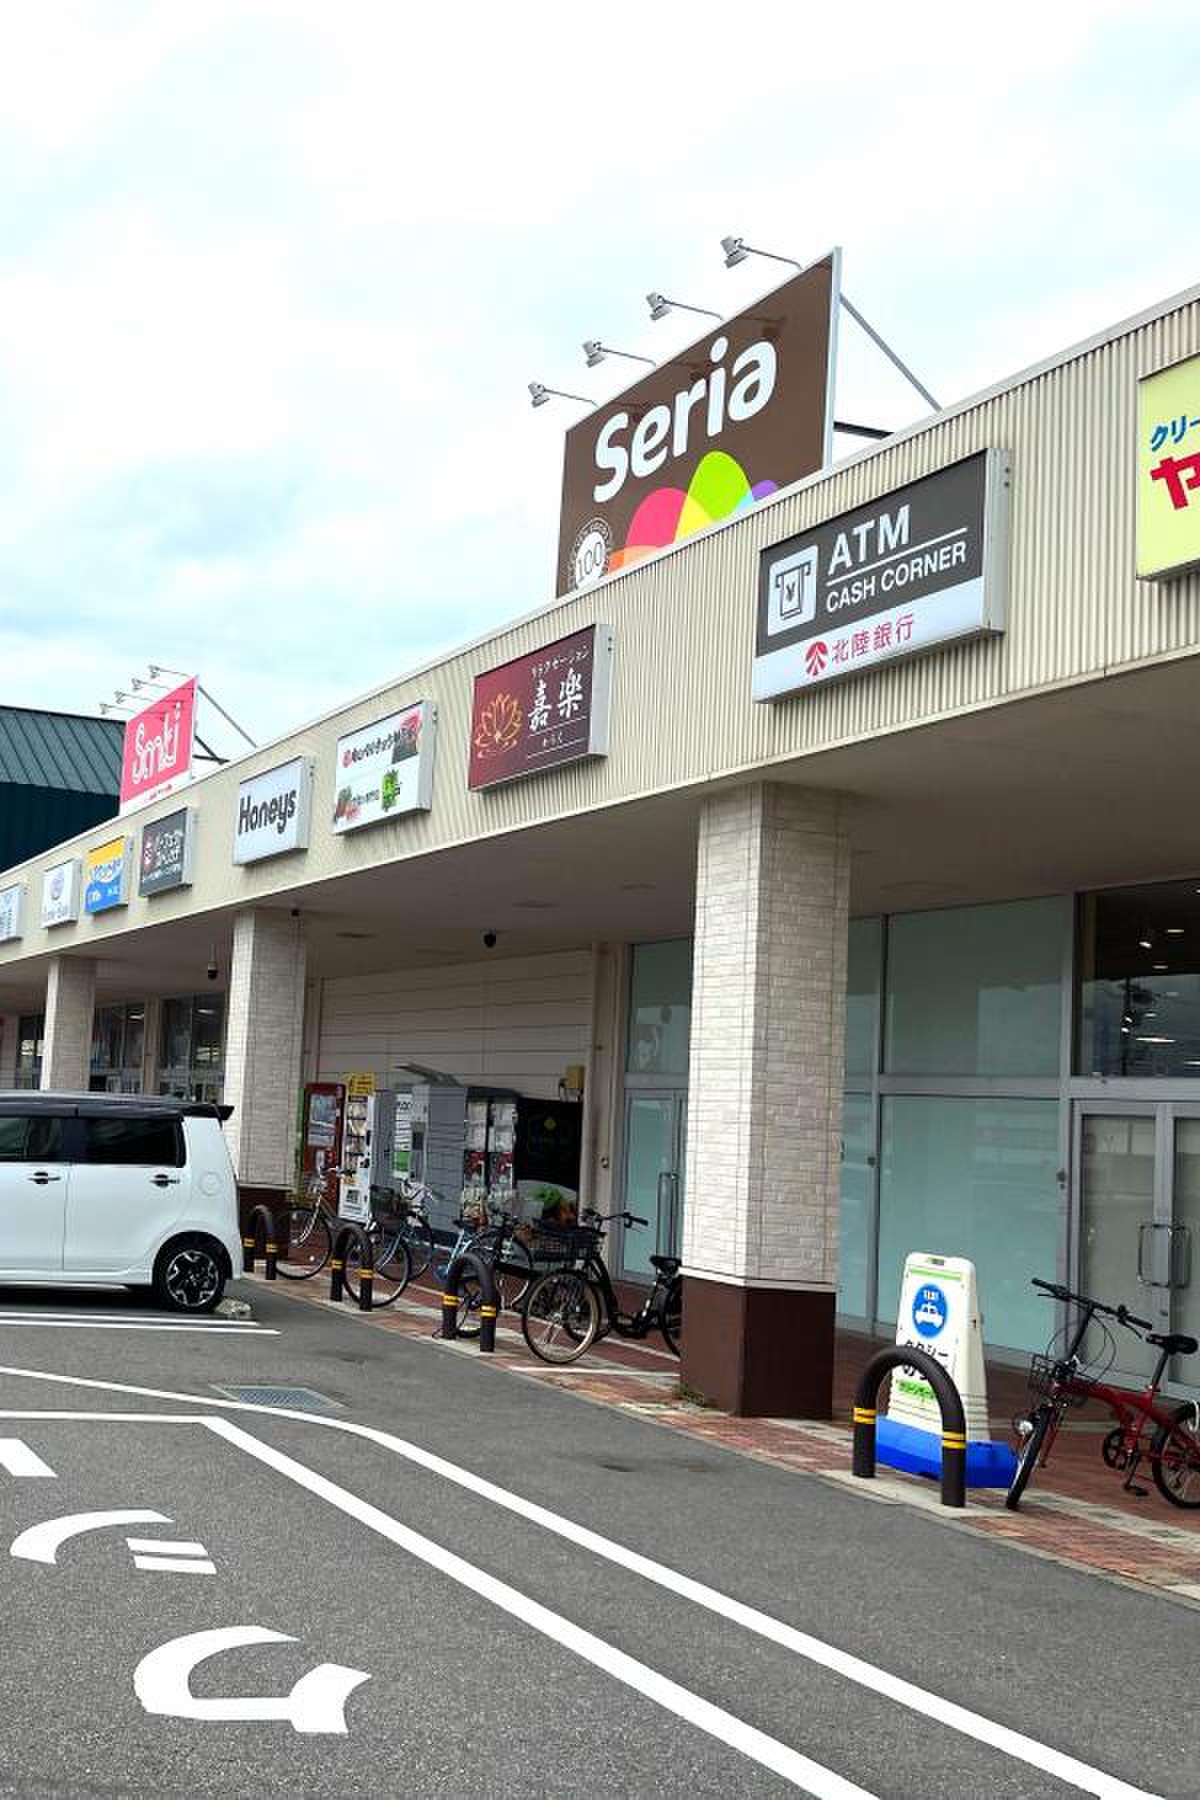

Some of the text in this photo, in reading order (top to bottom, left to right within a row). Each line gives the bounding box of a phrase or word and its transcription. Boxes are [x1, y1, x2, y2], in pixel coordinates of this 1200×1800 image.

[593, 336, 777, 503] Seria
[577, 541, 603, 583] 100
[827, 504, 911, 576] ATM
[826, 540, 967, 613] CASH CORNER
[831, 612, 914, 665] 北陸銀行
[528, 667, 583, 732] 嘉楽
[237, 789, 297, 835] Honeys
